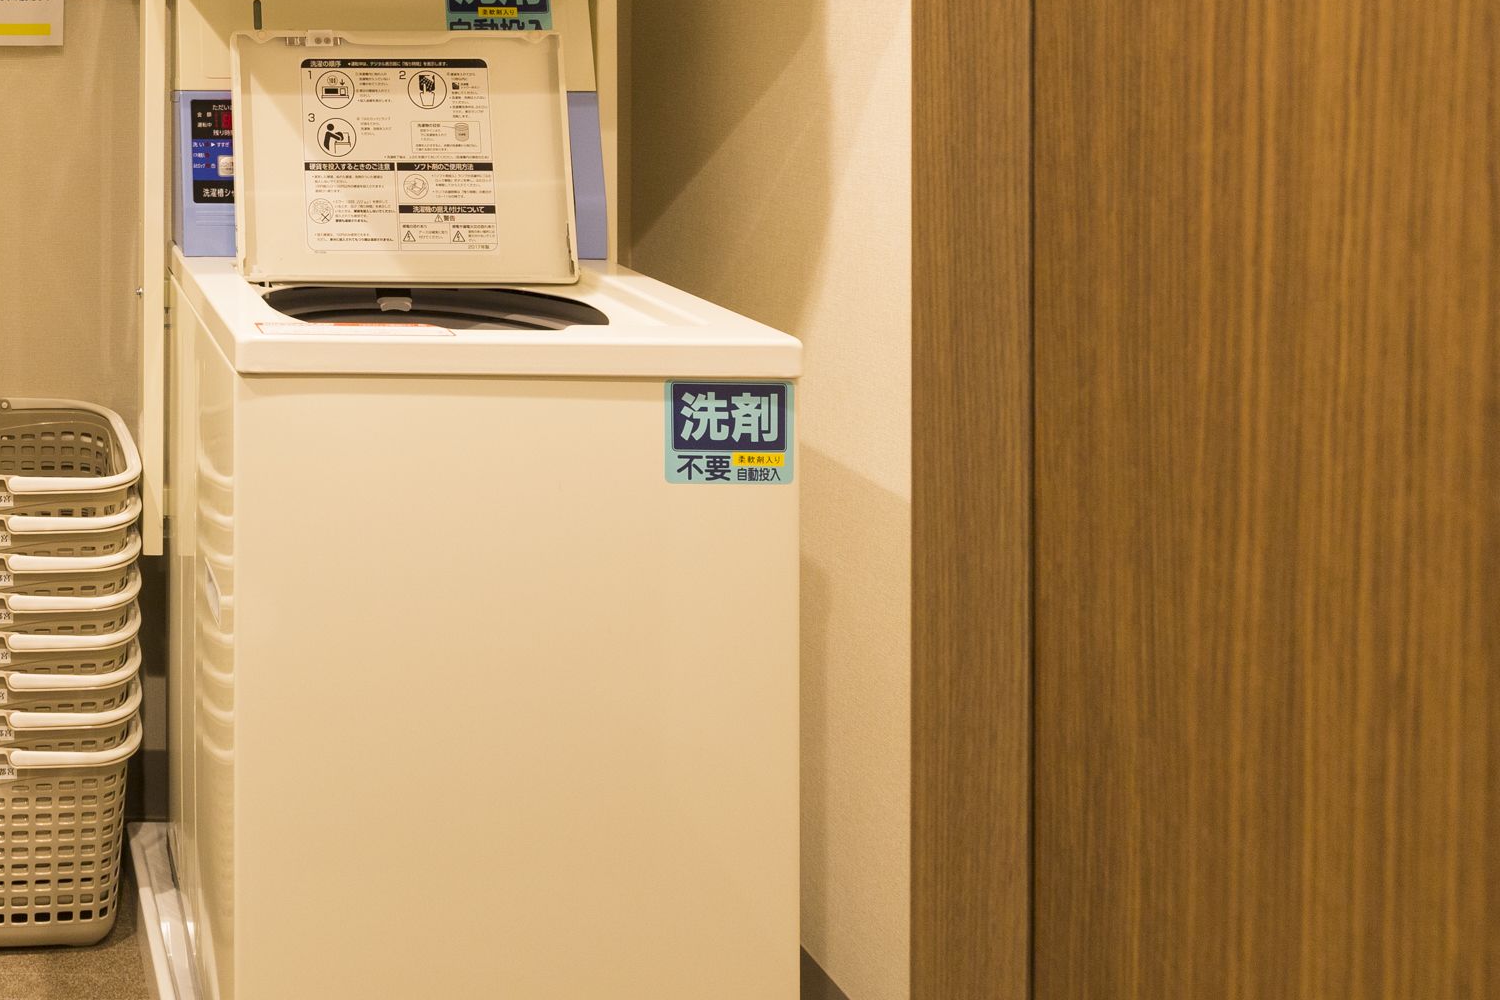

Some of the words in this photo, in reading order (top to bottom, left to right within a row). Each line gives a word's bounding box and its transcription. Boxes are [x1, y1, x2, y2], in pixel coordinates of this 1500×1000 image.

[308, 71, 312, 79] 1
[399, 70, 406, 79] 2
[308, 113, 315, 122] 3
[680, 392, 778, 442] 洗剤
[738, 456, 781, 464] 柔軟剤入り
[677, 455, 731, 481] 不要
[737, 468, 781, 481] 自動投入
